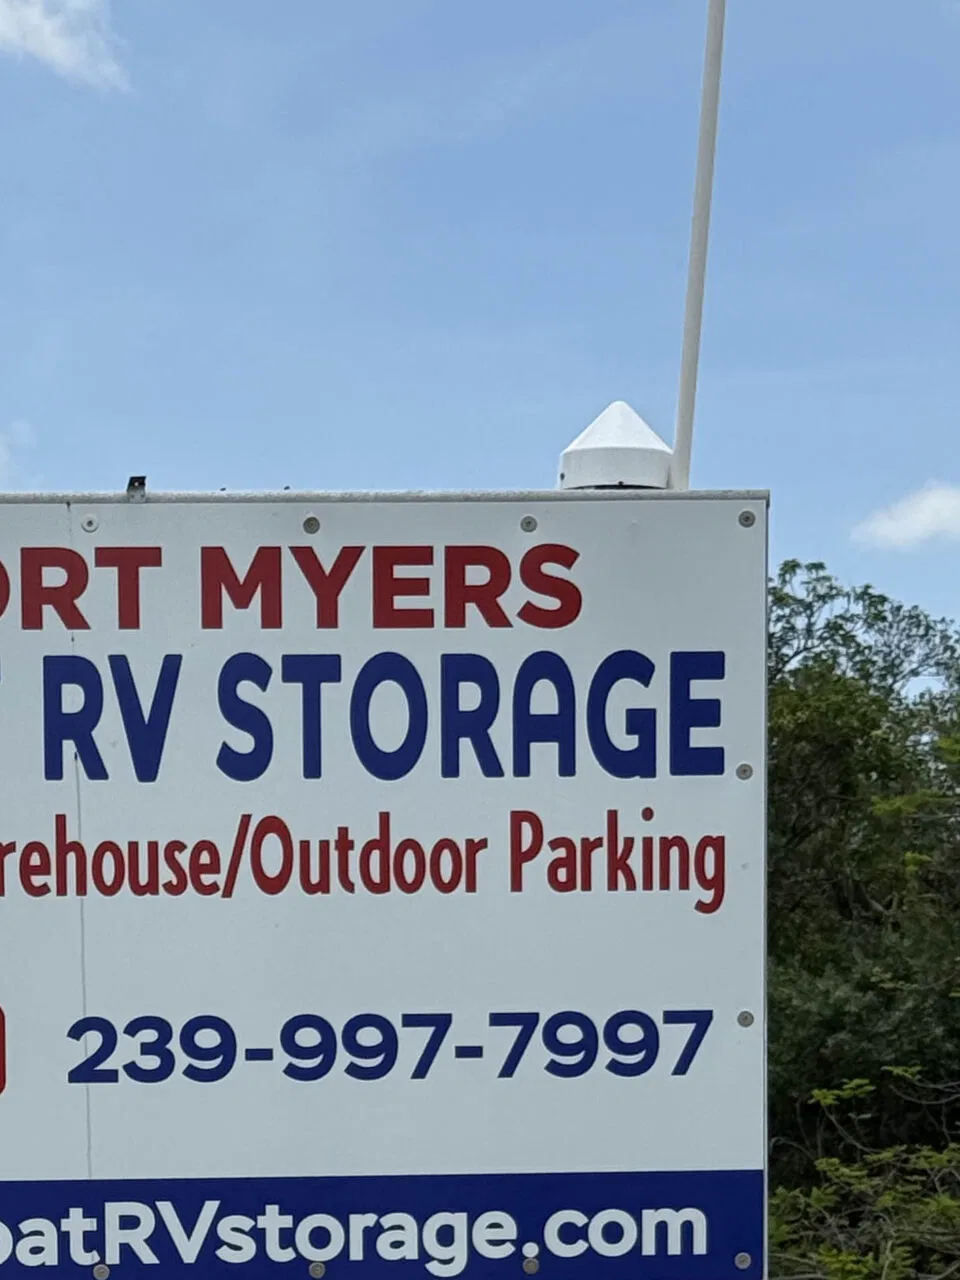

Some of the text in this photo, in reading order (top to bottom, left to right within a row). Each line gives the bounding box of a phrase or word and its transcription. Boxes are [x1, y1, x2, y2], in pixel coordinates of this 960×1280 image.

[201, 543, 583, 629] MYERS
[43, 653, 182, 783] RV
[216, 649, 726, 782] STORAGE
[510, 807, 726, 914] Parking
[66, 1009, 714, 1083] 239-997-7997
